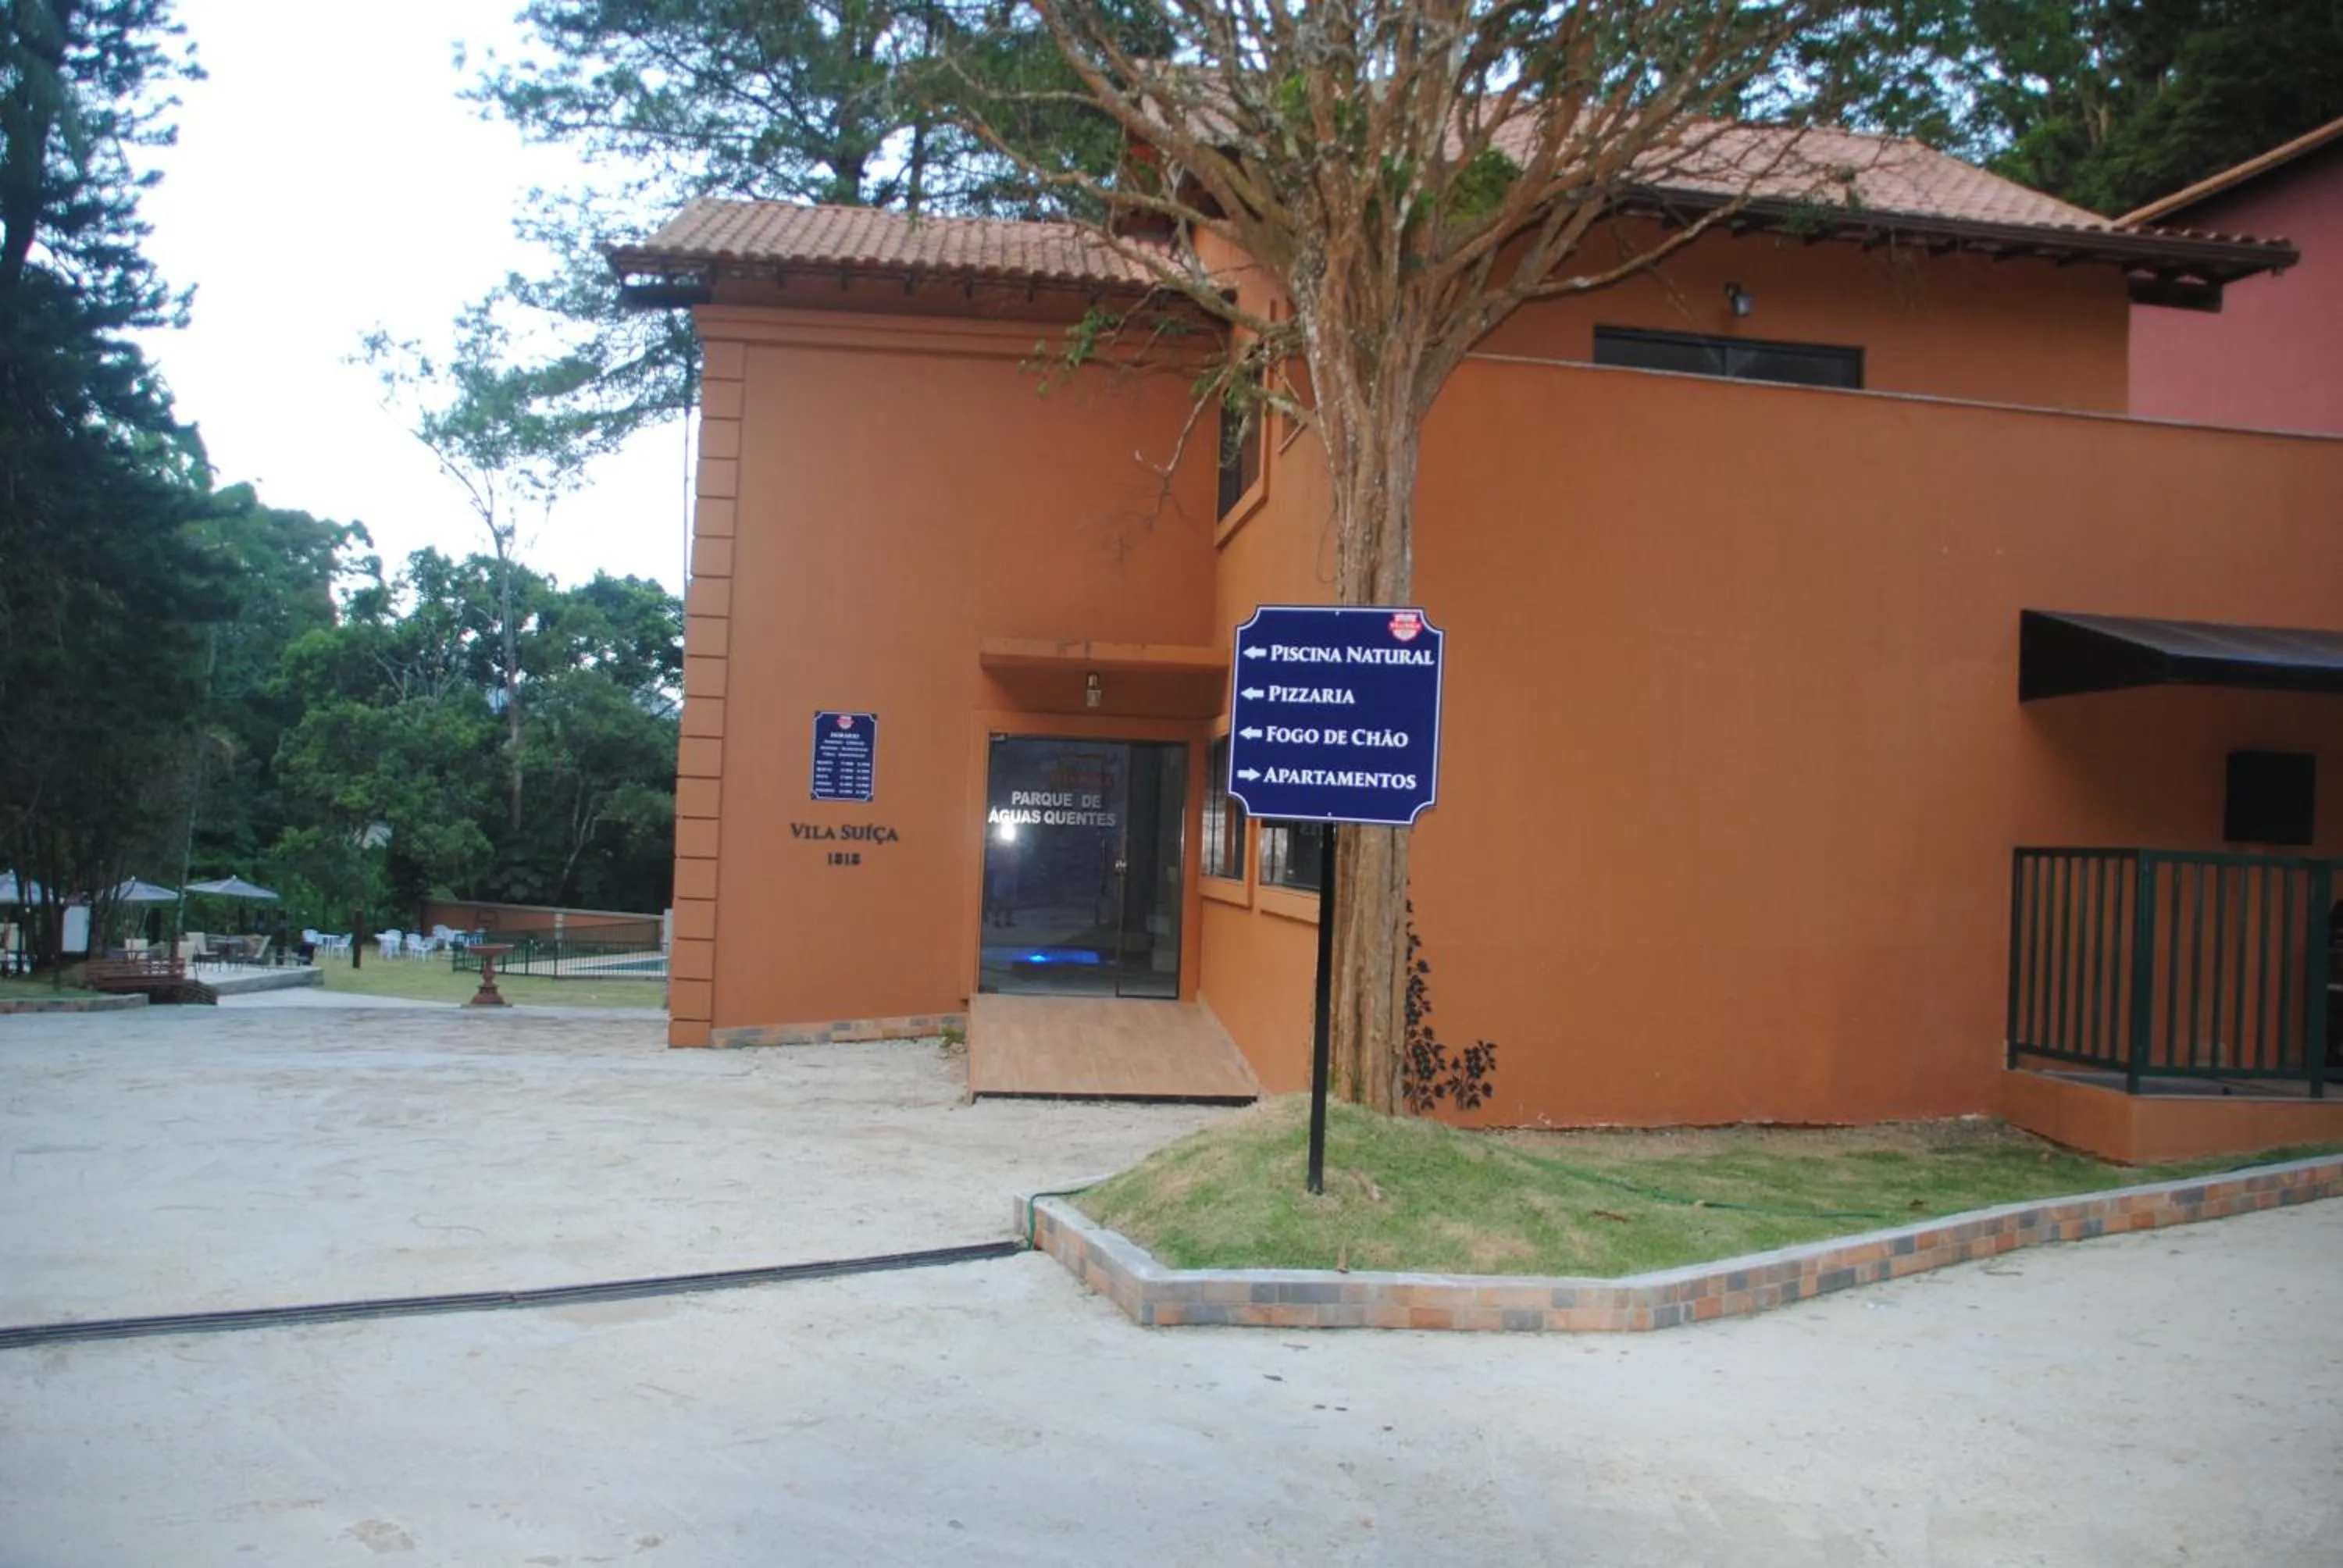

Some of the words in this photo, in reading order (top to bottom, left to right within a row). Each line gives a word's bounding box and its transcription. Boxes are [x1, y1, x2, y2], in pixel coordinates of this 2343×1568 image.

[1270, 644, 1342, 662] PISCINA
[1346, 647, 1435, 665] NATURAL
[1268, 686, 1355, 704] PIZZARIA
[1265, 725, 1319, 743] FOGO
[1324, 730, 1347, 745] DE
[1351, 729, 1409, 747] CHÃO
[1263, 767, 1416, 789] APARTAMENTOS
[1011, 790, 1073, 807] PARQUE
[1082, 794, 1102, 808] DE
[988, 806, 1041, 825] ÁGUAS
[1043, 810, 1117, 826] QUENTES
[790, 823, 836, 840] VILA
[840, 823, 900, 844] SUÍÇA
